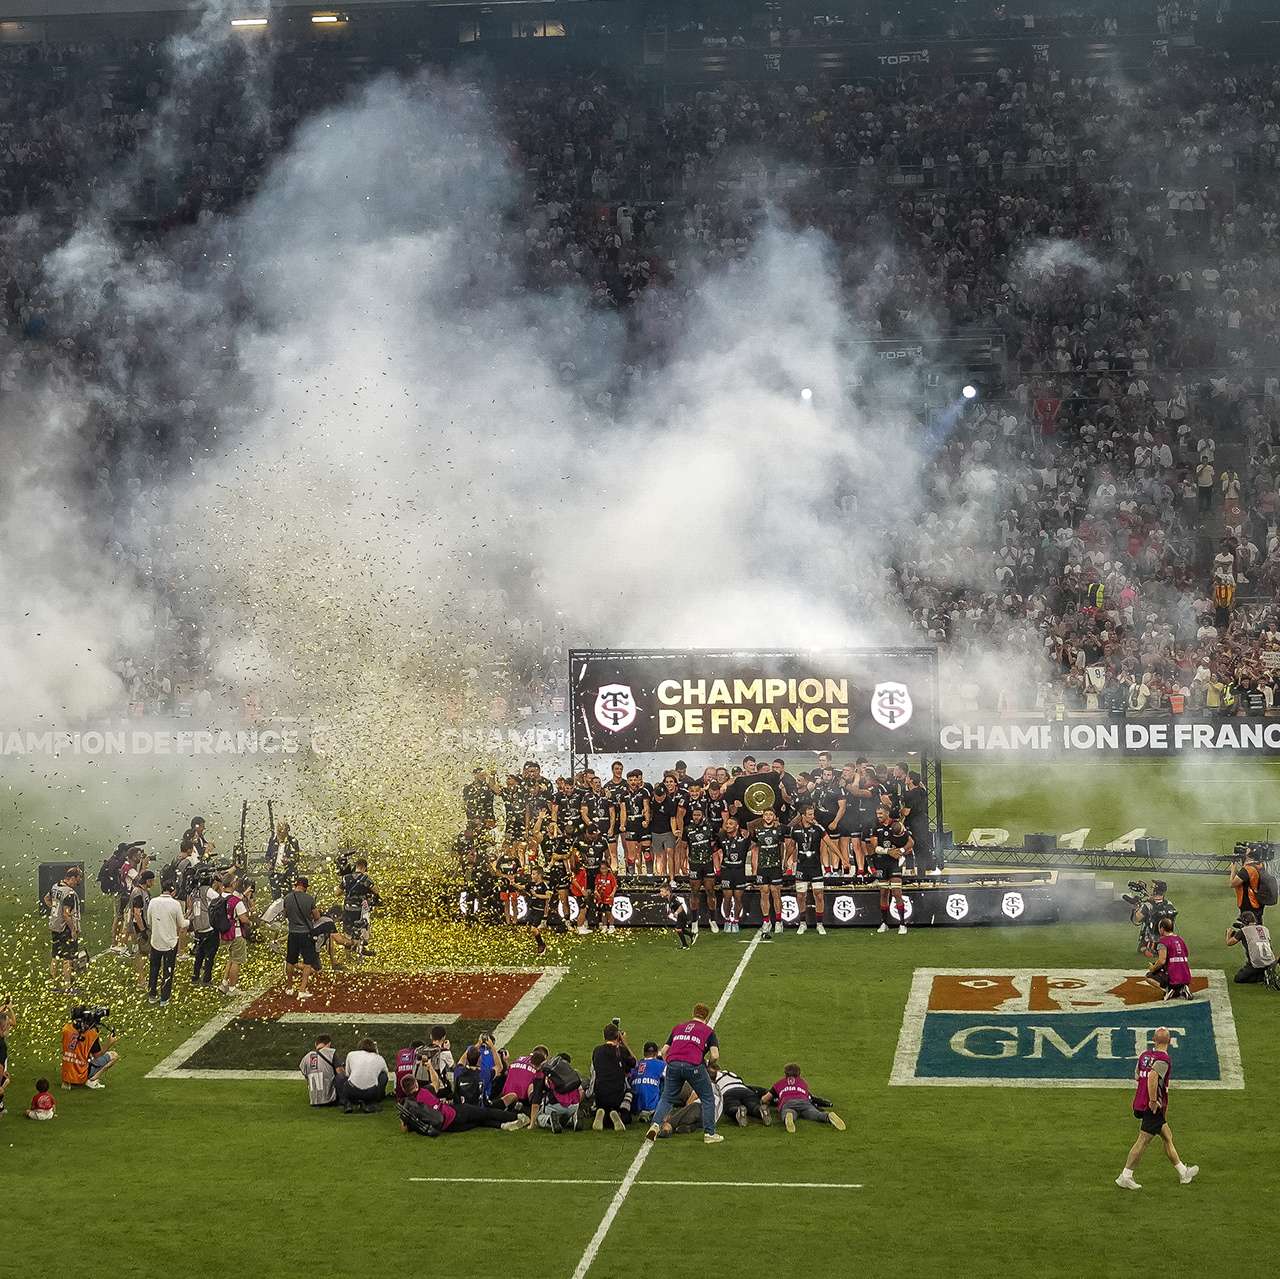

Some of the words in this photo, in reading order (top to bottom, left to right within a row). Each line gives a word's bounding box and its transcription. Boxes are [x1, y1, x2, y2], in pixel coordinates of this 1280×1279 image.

[659, 679, 849, 705] CHAMPION
[660, 708, 703, 734] DE
[712, 707, 849, 733] FRANCE
[132, 730, 171, 755] DE
[176, 730, 298, 755] FRANCE
[1125, 724, 1167, 749] DE
[949, 1025, 1186, 1060] GMF
